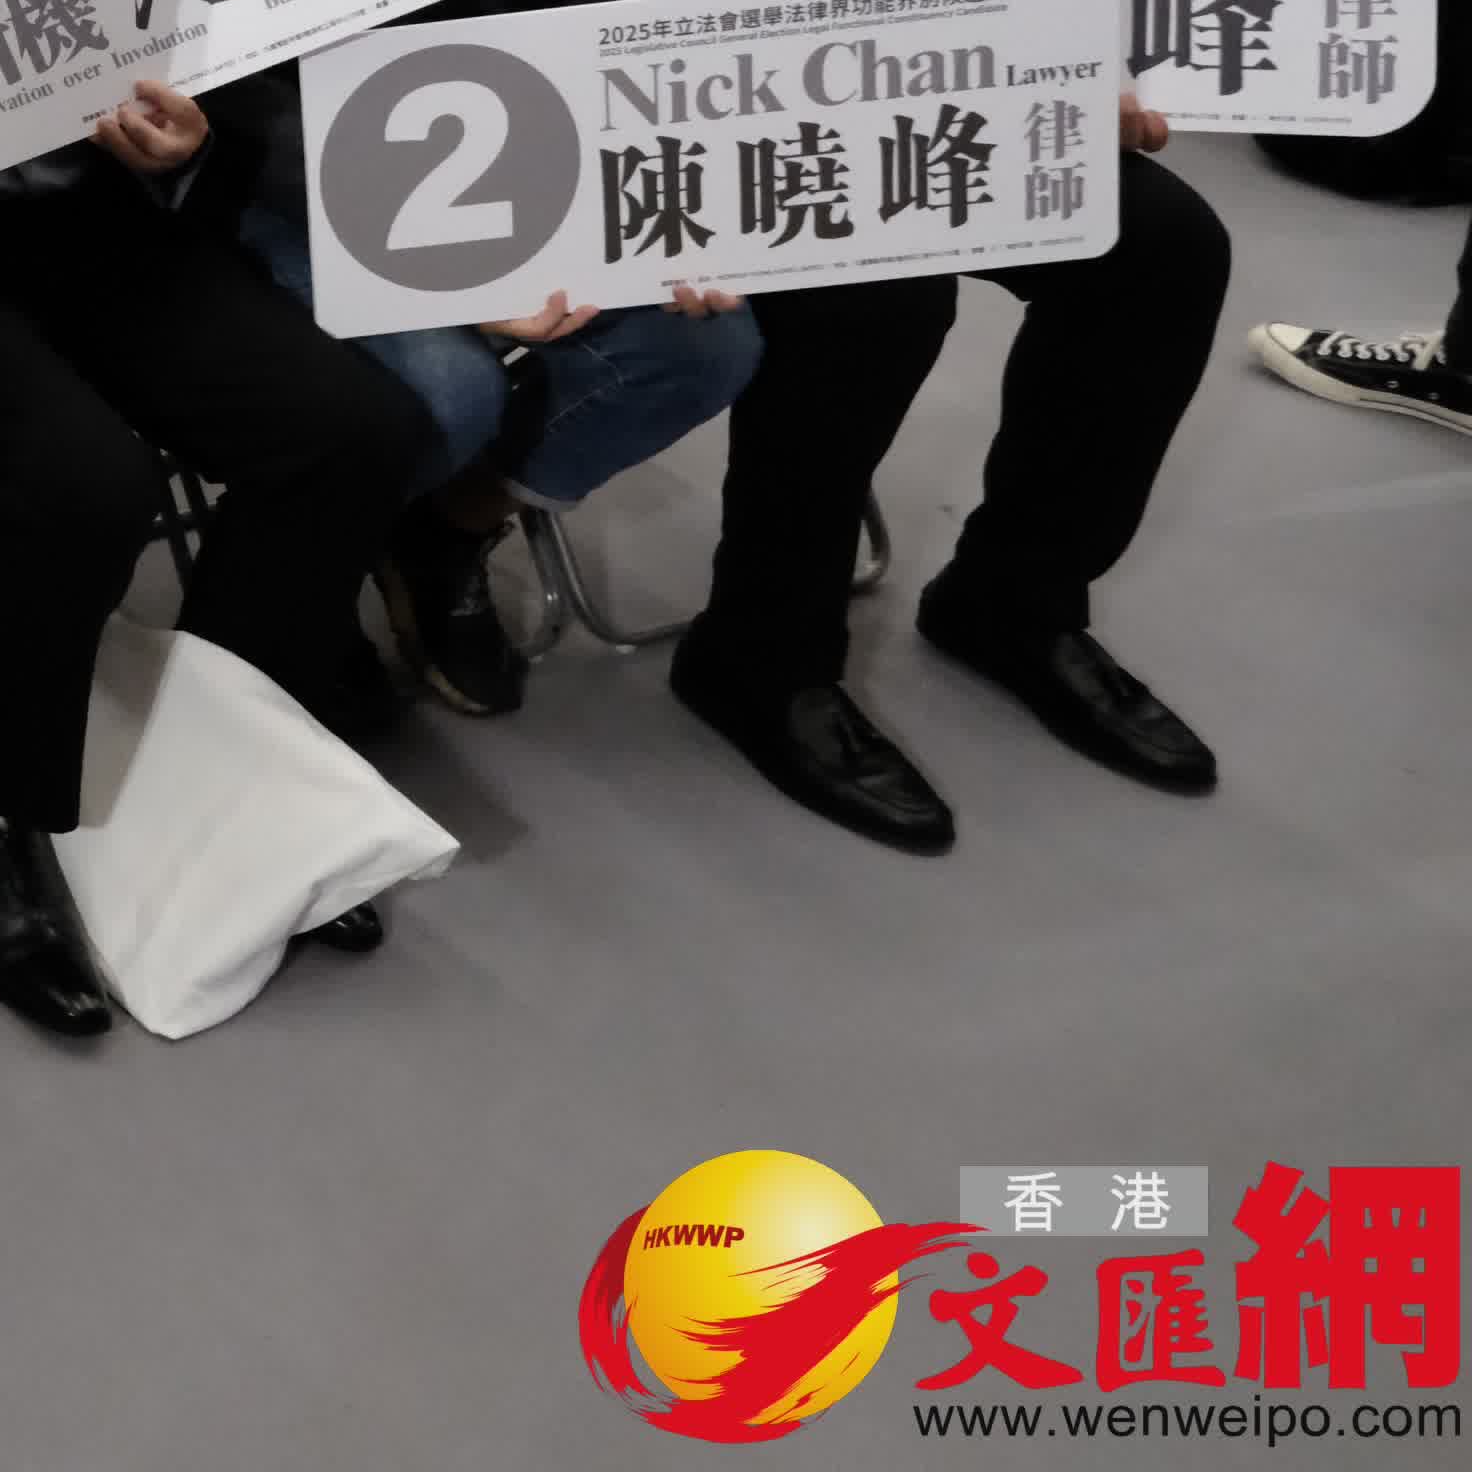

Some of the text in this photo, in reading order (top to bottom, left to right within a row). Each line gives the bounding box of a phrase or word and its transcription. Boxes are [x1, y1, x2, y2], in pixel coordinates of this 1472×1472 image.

[63, 62, 103, 91] over
[109, 21, 209, 70] Involution
[598, 39, 1103, 132] Nick Chan Lawyer
[383, 80, 514, 251] 2
[599, 103, 999, 265] 陳曉峰
[1024, 99, 1088, 222] 律師
